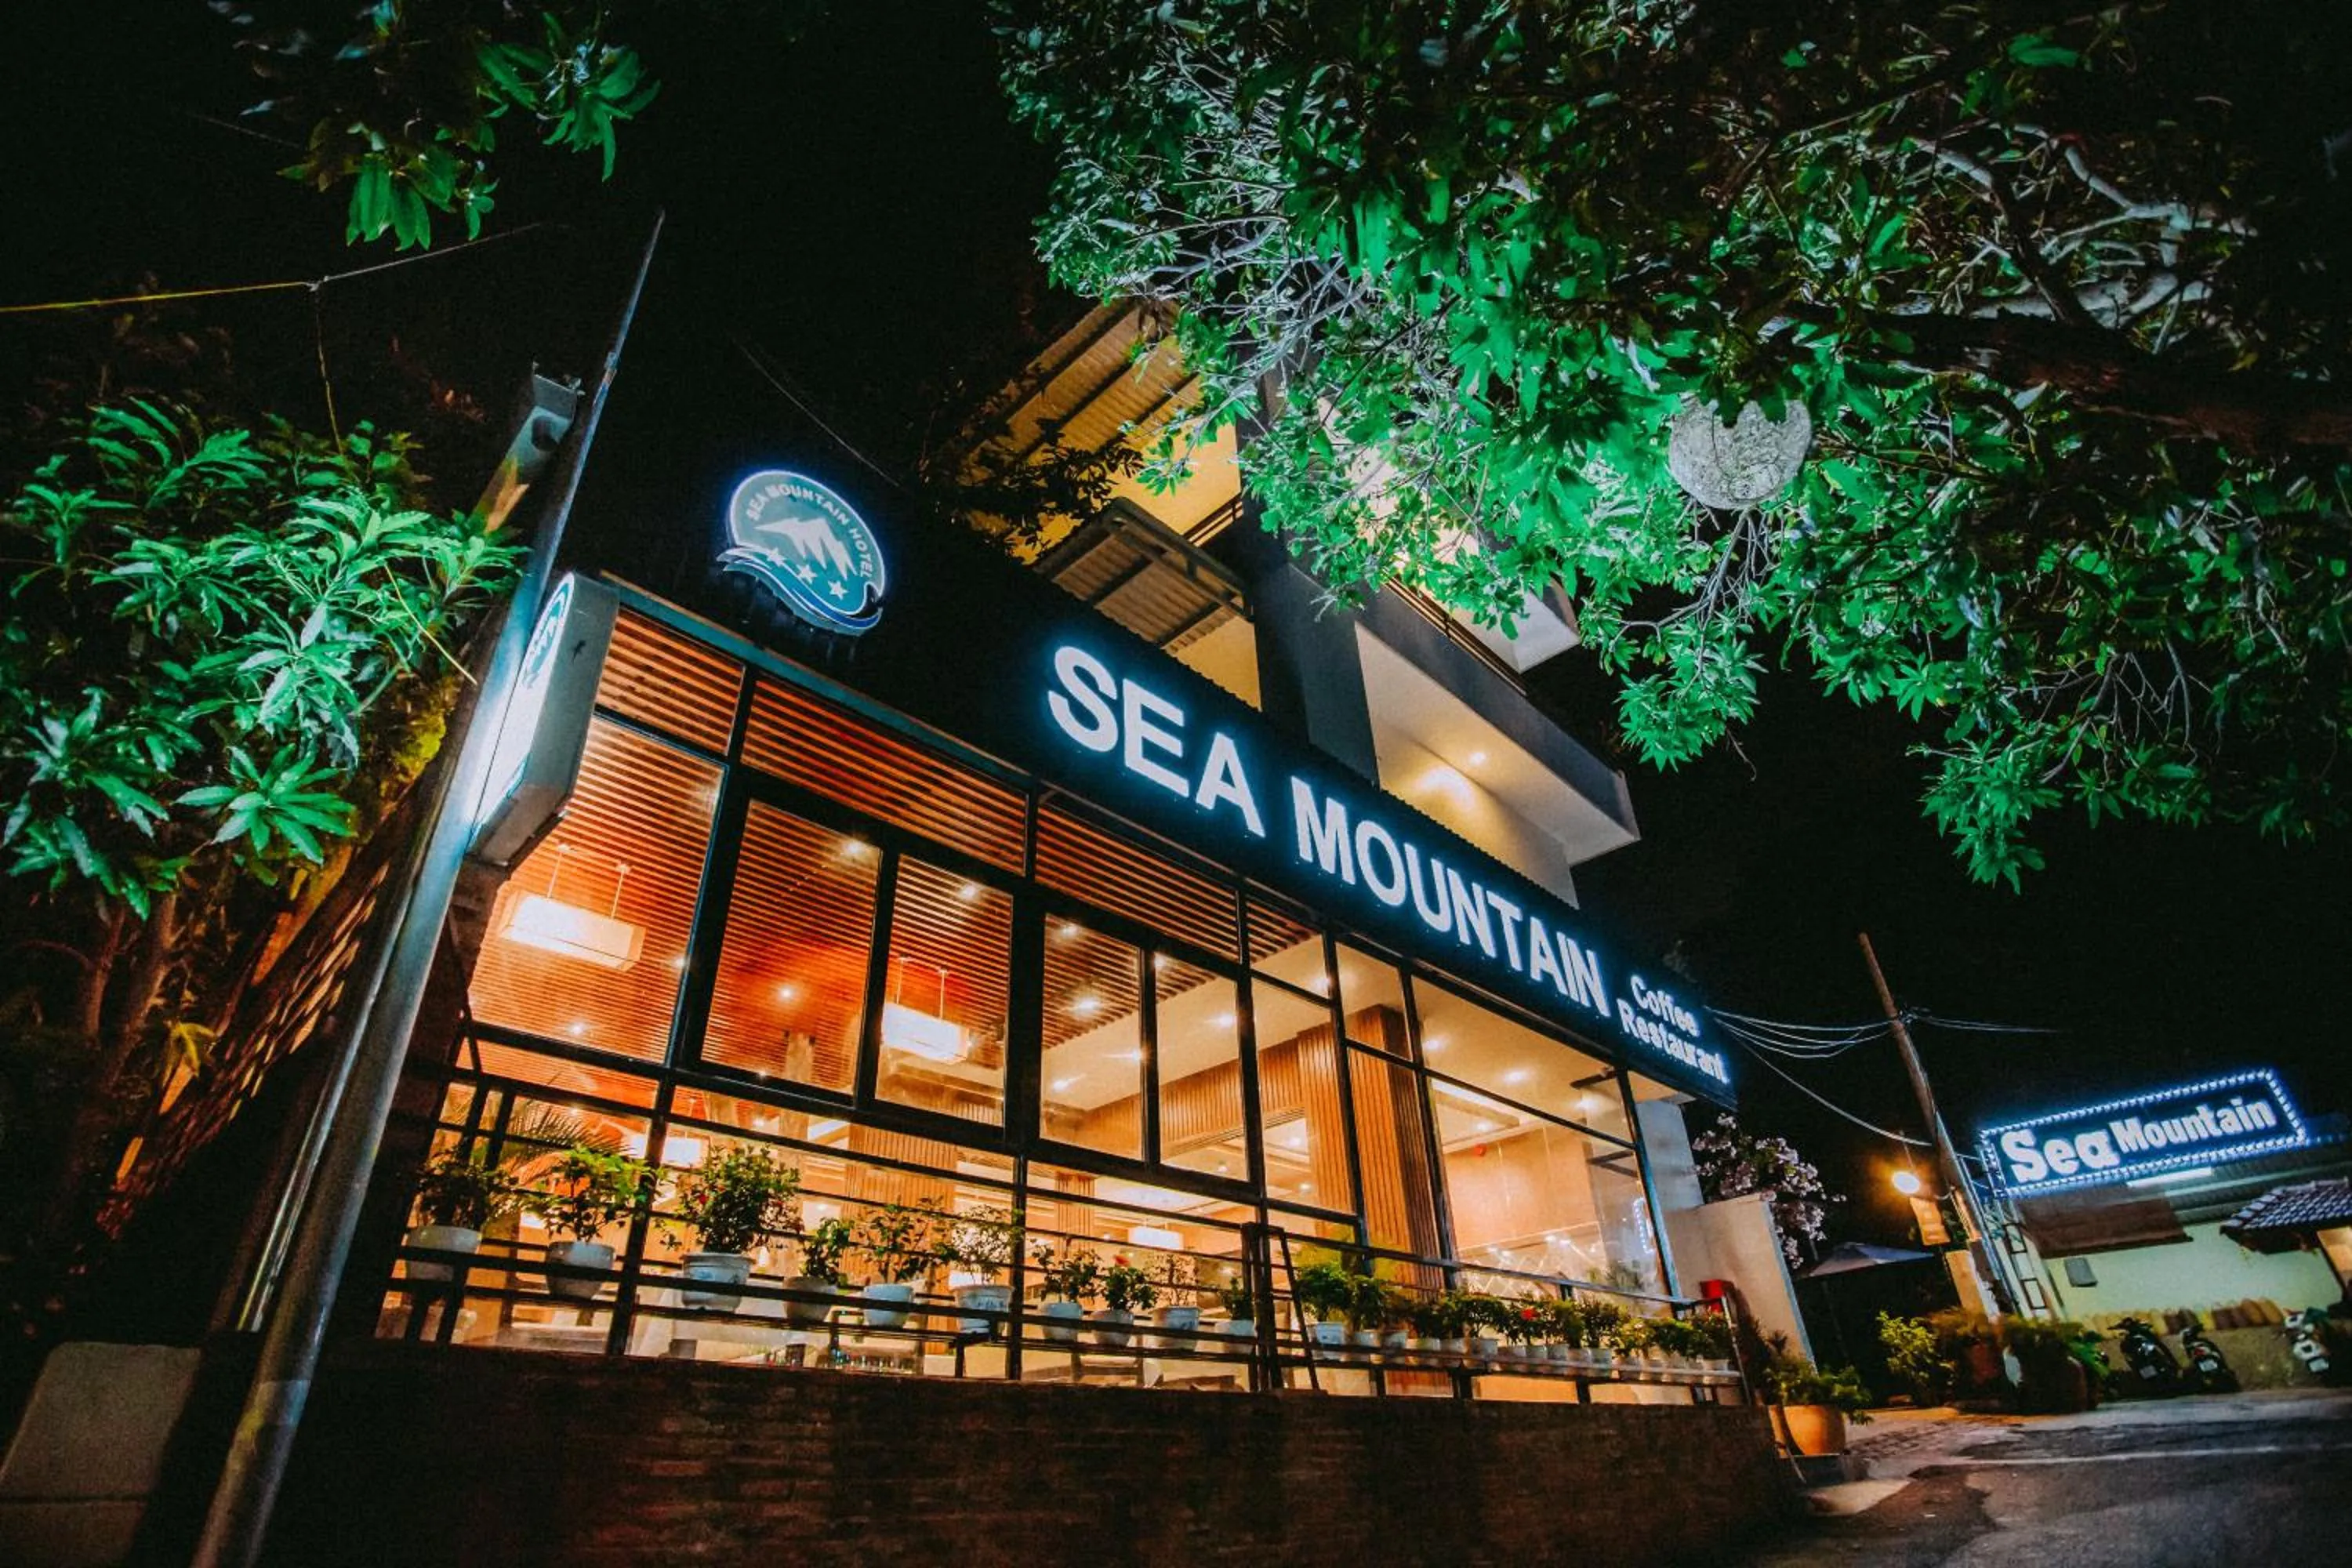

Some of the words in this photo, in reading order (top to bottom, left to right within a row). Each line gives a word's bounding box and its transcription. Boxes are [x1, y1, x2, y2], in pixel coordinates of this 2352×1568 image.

[746, 493, 769, 521] SEA
[765, 484, 851, 525] MOUNTAIN
[848, 527, 873, 578] HOTEL
[1047, 645, 1266, 838] SEA
[1290, 775, 1611, 1018] MOUNTAIN
[1617, 998, 1731, 1085] Restaurant
[1631, 975, 1700, 1037] Coffee
[1999, 1127, 2122, 1184] Sea
[2107, 1097, 2278, 1155] Mountain
